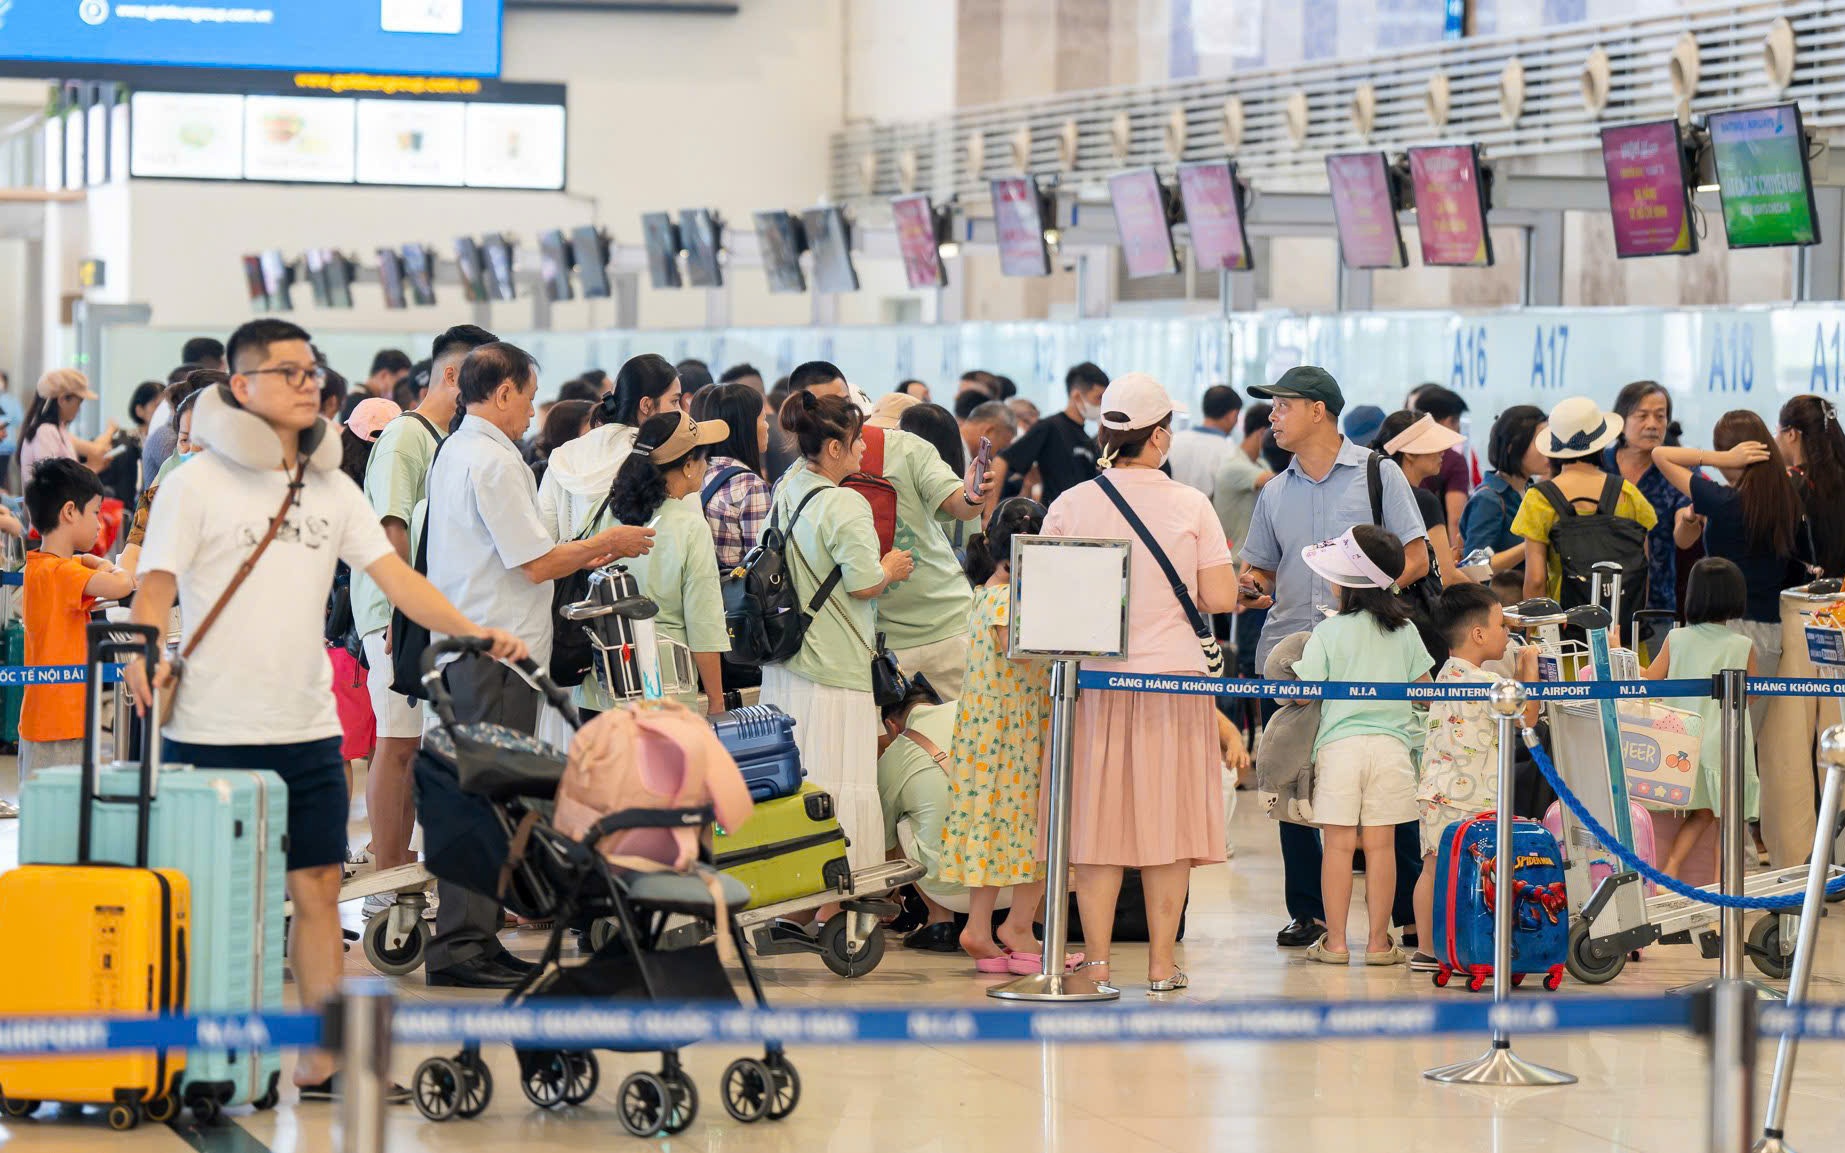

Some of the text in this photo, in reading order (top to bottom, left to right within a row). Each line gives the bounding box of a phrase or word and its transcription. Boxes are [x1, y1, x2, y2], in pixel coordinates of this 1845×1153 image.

[1451, 326, 1488, 388] A16
[1531, 325, 1569, 388] A17
[1709, 322, 1754, 392] A18
[1810, 321, 1845, 392] A1
[20, 667, 36, 681] TẾ
[38, 668, 60, 683] NỘI
[1182, 679, 1224, 692] KHÔNG
[1226, 681, 1260, 694] QUỐC
[1262, 682, 1277, 694] TẾ
[1279, 684, 1300, 697] NỘI
[1303, 684, 1322, 696] BÀI
[1349, 686, 1377, 697] N.I.A
[1406, 686, 1591, 697] NOIBAI INTERNAL AIRPORT
[1620, 686, 1647, 695] N.I.A
[1789, 682, 1831, 693] KHÔNG
